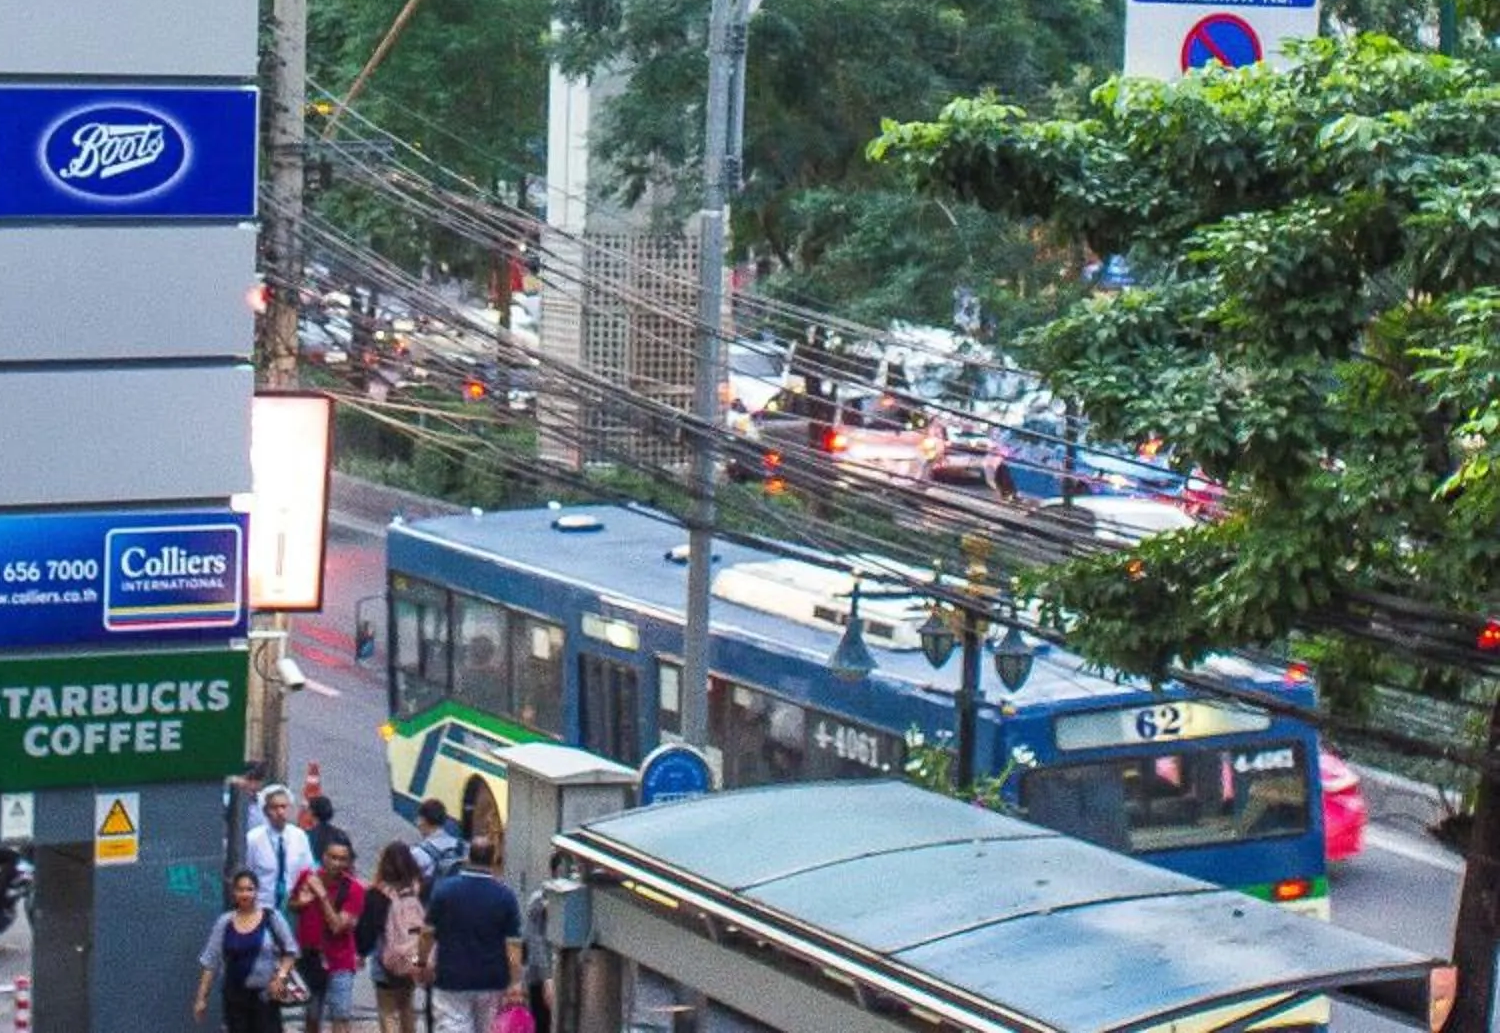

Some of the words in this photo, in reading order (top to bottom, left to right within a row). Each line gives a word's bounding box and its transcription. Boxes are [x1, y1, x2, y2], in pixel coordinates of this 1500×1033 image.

[60, 122, 165, 180] Boots
[3, 561, 41, 583] 656
[47, 559, 98, 581] 7000
[121, 546, 226, 578] Colliers
[121, 577, 225, 592] INTERNATIONAL
[23, 719, 185, 757] COFFEE
[1136, 704, 1181, 739] 62
